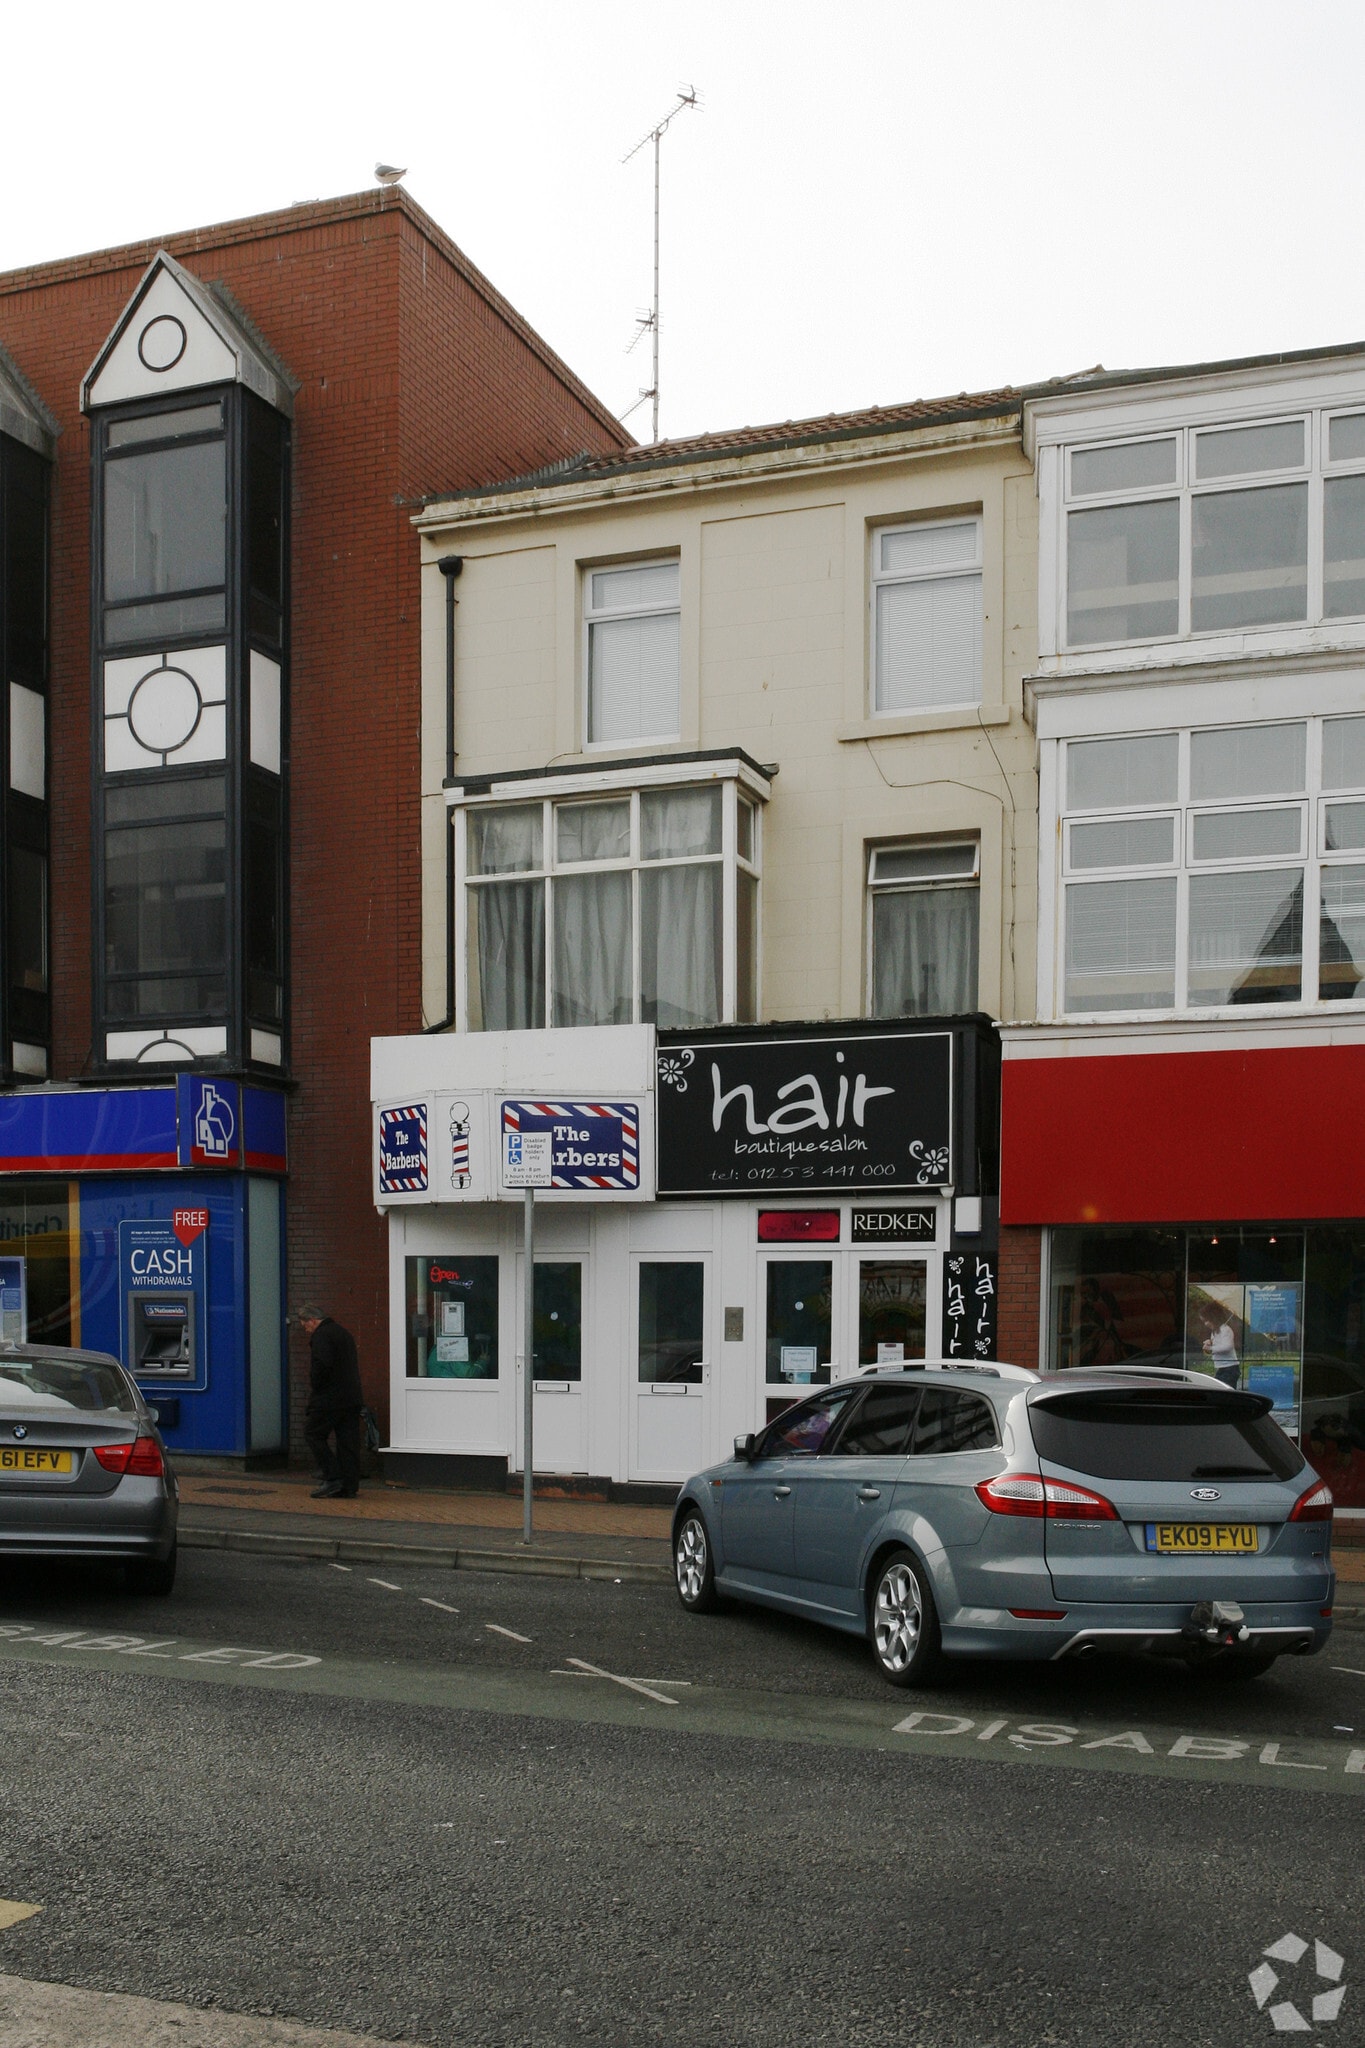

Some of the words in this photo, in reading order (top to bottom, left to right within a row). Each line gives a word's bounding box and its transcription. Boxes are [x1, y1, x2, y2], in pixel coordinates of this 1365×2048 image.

[711, 1051, 896, 1135] hair
[395, 1130, 409, 1146] The
[553, 1125, 591, 1142] The
[386, 1151, 421, 1171] Barbers
[552, 1147, 621, 1168] rbers
[709, 1168, 739, 1182] tel:
[747, 1166, 815, 1180] 01253
[822, 1165, 855, 1178] 441
[861, 1163, 896, 1177] 000
[175, 1211, 206, 1227] FREE
[854, 1213, 934, 1231] REDKEN
[130, 1249, 192, 1275] CASH
[132, 1276, 193, 1286] WITHDRAWALS
[430, 1265, 460, 1283] Open
[975, 1256, 994, 1335] hair
[947, 1277, 966, 1355] hair
[0, 1451, 19, 1467] 61
[24, 1452, 60, 1469] EFV
[1159, 1526, 1212, 1546] EK09
[1215, 1527, 1253, 1547] FYU
[892, 1711, 1365, 1774] DISABL
